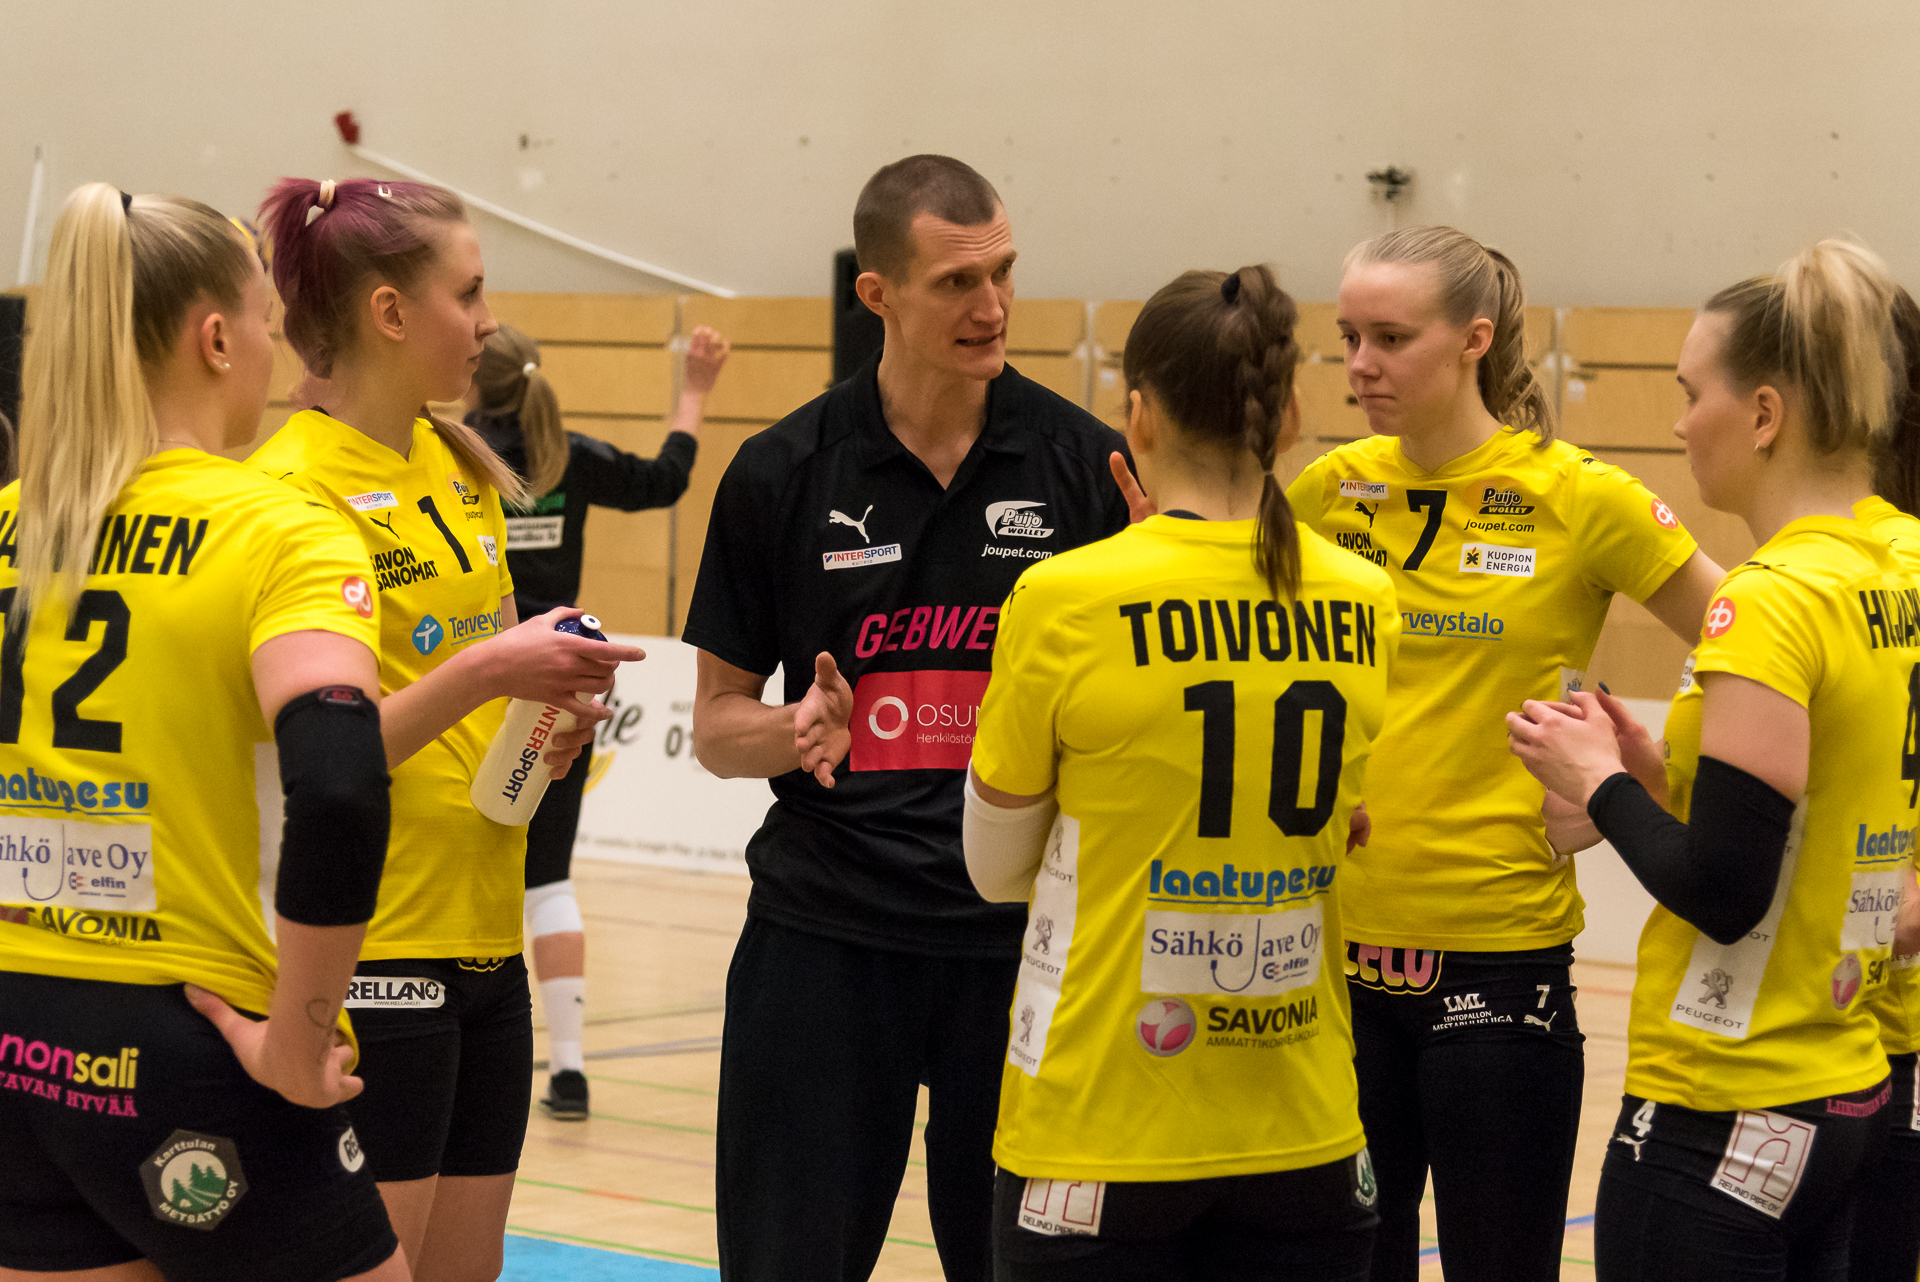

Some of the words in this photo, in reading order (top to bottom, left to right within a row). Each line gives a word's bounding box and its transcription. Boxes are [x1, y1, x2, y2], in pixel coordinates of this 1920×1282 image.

[1482, 487, 1523, 506] Puijo
[1488, 506, 1528, 514] WOLLEY
[1001, 508, 1043, 529] Puijo
[1008, 527, 1046, 537] WOLLEY
[1402, 490, 1447, 571] 7
[1463, 519, 1535, 532] joupet.com
[417, 495, 474, 574] 1
[833, 545, 898, 562] INTERSPORT
[981, 543, 1053, 560] joupet.com
[1487, 550, 1532, 563] KUOPION
[1486, 561, 1531, 573] ENERGIA
[855, 605, 1001, 659] GEBWE
[1119, 599, 1376, 667] TOIVONEN
[1401, 611, 1504, 636] rveystalo
[0, 586, 131, 754] 12
[502, 705, 560, 805] NTERSPORT
[1183, 680, 1347, 838] 10
[107, 843, 148, 879] Oy
[91, 876, 126, 889] elfin
[1150, 859, 1336, 907] laatupesu
[1150, 928, 1243, 957] Sähkö
[1443, 993, 1486, 1013] LML
[1536, 985, 1550, 1009] 7
[1207, 995, 1318, 1035] SAVONIA
[1675, 1003, 1744, 1030] PEUGEOT
[66, 1089, 138, 1117] HYVÄÄ
[1632, 1101, 1656, 1137] 4
[154, 1139, 216, 1167] Karttulan
[1718, 1179, 1750, 1199] RELINO
[1750, 1193, 1768, 1208] PIPE
[1767, 1202, 1781, 1213] OY
